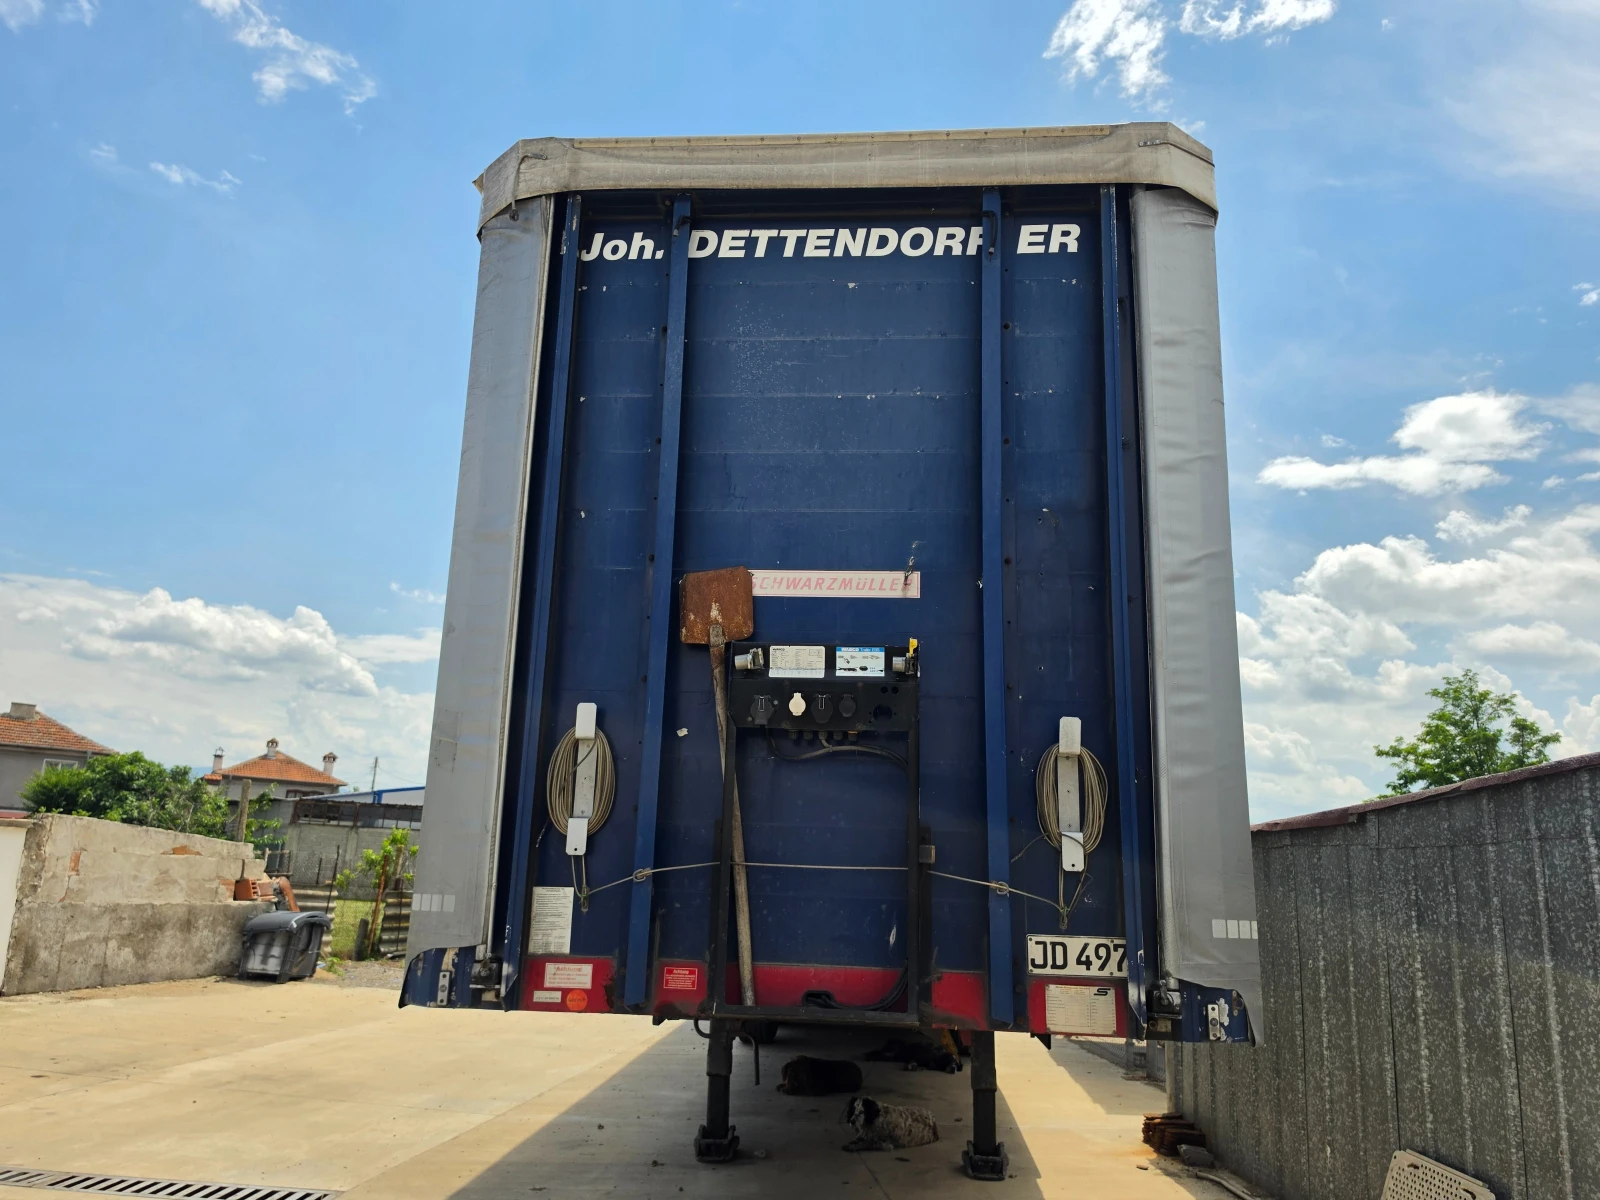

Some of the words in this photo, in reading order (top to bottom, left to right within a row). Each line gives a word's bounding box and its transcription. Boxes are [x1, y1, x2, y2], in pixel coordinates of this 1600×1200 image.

[580, 231, 664, 261] Joh.
[1030, 941, 1068, 970] JD
[1076, 943, 1127, 972] 497
